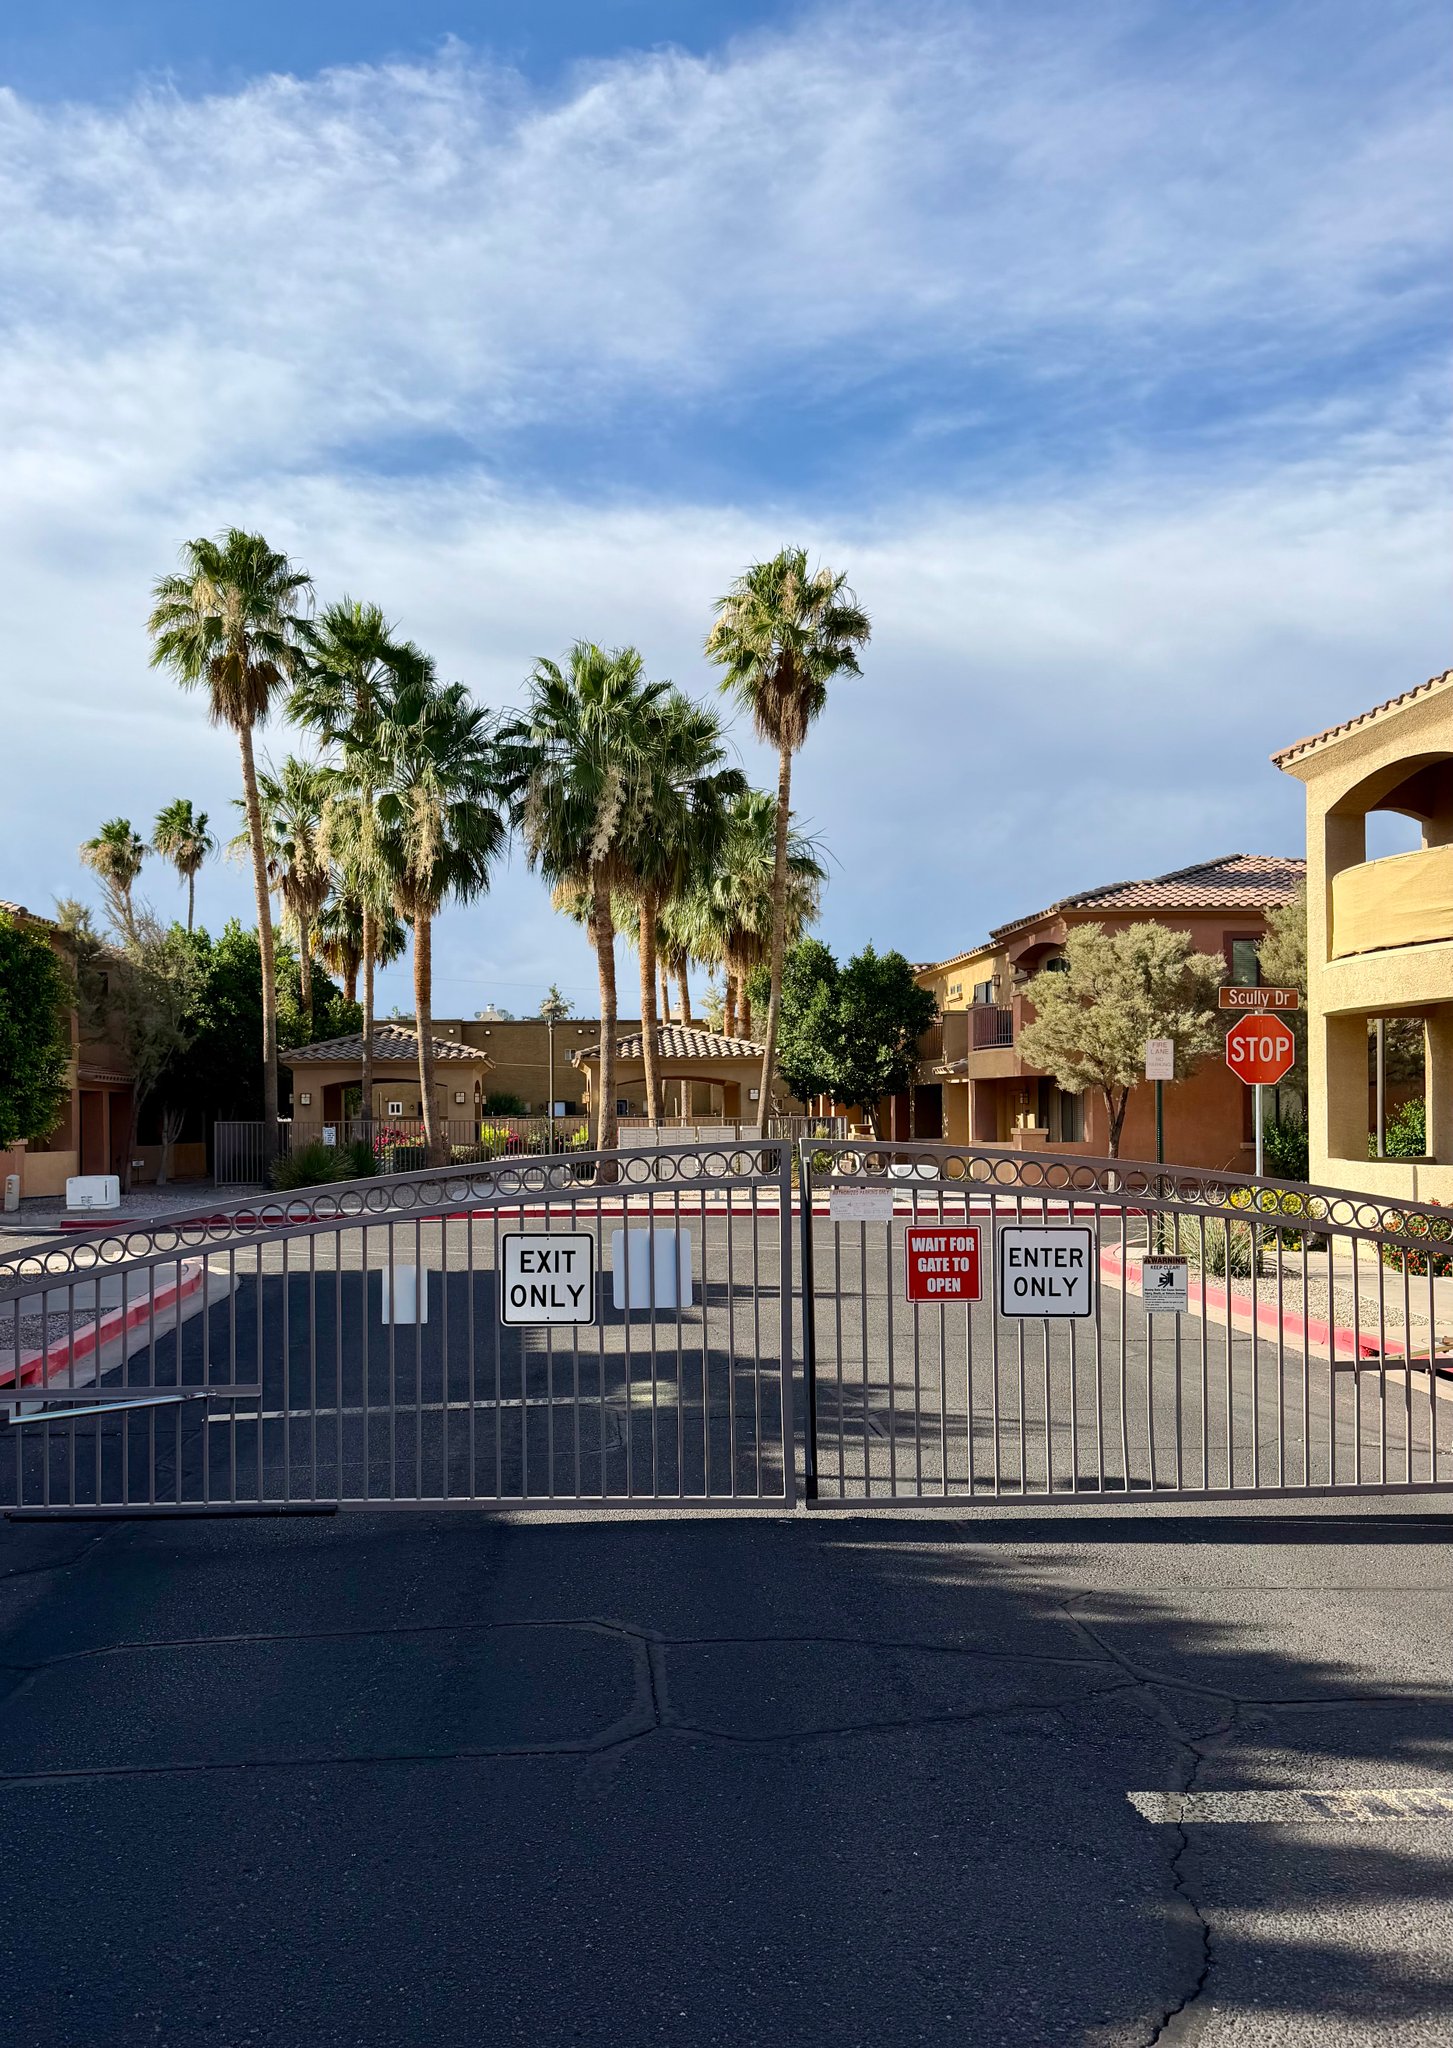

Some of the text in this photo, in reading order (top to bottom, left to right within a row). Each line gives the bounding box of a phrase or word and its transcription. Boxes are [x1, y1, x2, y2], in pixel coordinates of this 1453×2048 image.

[1229, 989, 1290, 1007] Scully Dr
[1231, 1036, 1290, 1062] STOP
[911, 1237, 975, 1252] WAIT FOR
[520, 1250, 576, 1273] EXIT
[917, 1257, 970, 1273] GATE TO
[1009, 1247, 1084, 1268] ENTER
[1152, 1256, 1186, 1264] WARNING
[926, 1277, 961, 1293] OPEN
[1013, 1276, 1079, 1297] ONLY
[510, 1284, 586, 1308] ONLY
